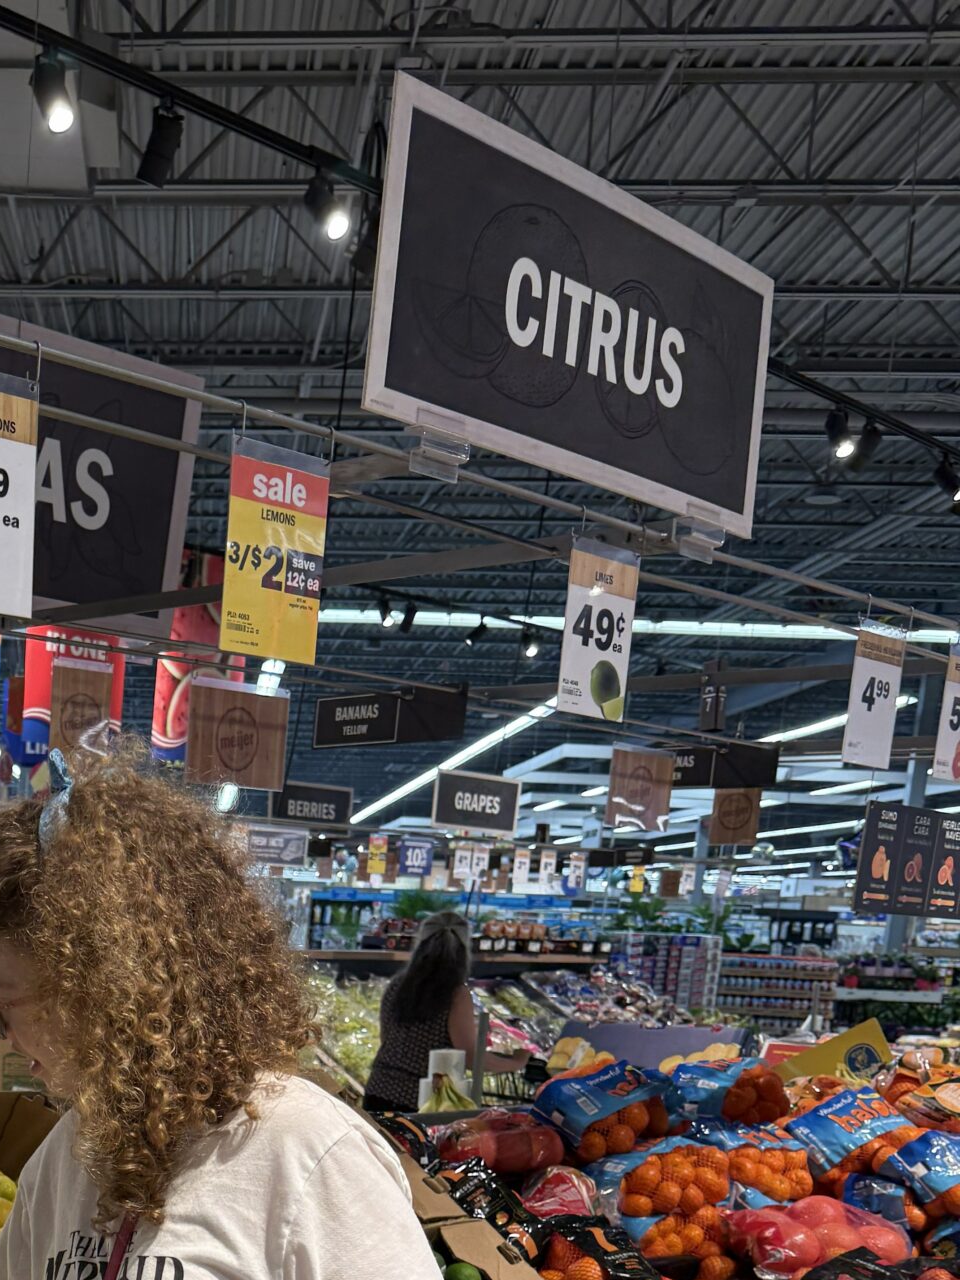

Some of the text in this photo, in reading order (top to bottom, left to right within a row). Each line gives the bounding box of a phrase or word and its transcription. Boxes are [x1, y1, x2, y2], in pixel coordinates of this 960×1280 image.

[505, 256, 686, 408] CITRUS
[253, 471, 307, 508] sale
[2, 514, 20, 529] ea
[261, 508, 296, 527] LEMONS
[292, 557, 316, 572] save
[306, 576, 320, 592] ea
[595, 571, 613, 585] LIMES
[70, 636, 108, 661] ONE
[612, 643, 623, 653] ea
[335, 704, 379, 721] BANANAS
[343, 724, 368, 736] YELLOW
[220, 730, 254, 748] meijer
[287, 799, 336, 820] BERRIES
[455, 791, 500, 814] GRAPES
[945, 831, 960, 841] NAVE
